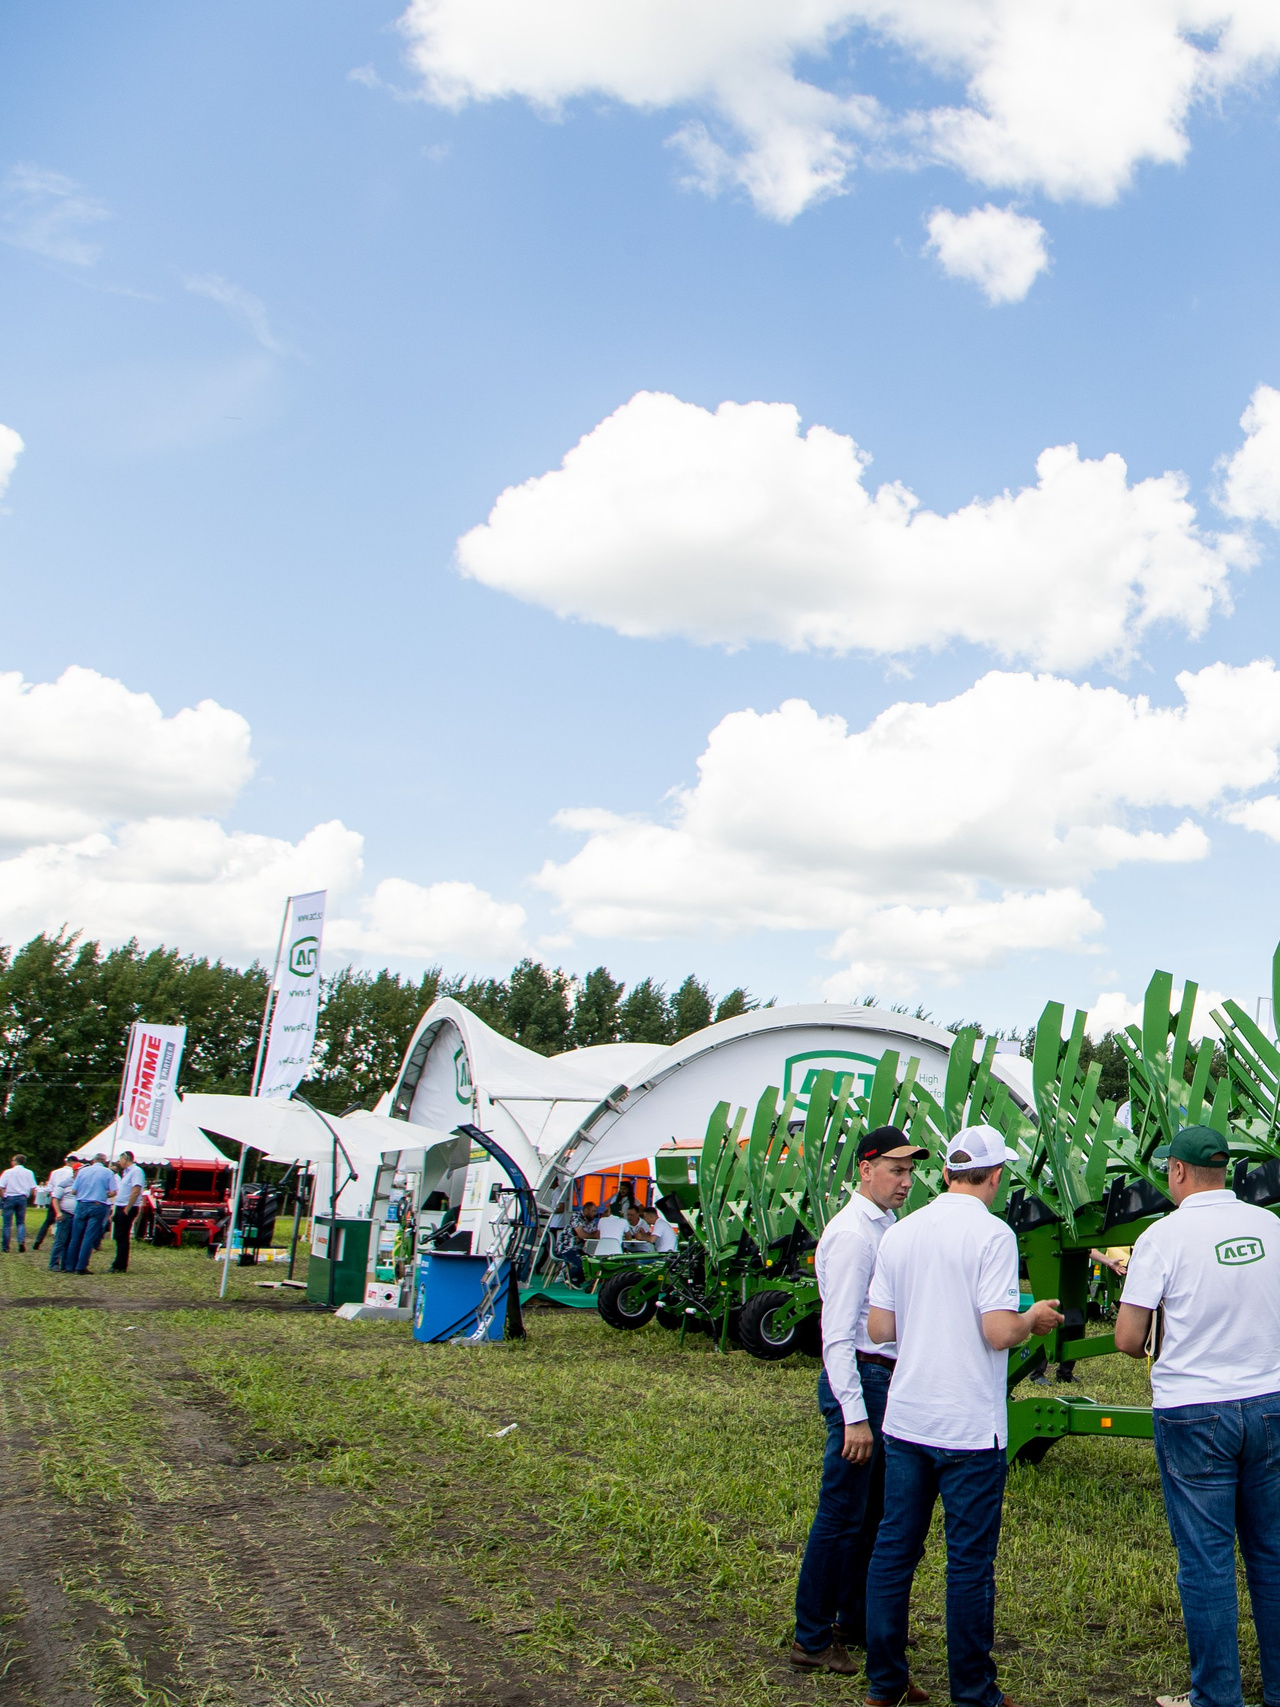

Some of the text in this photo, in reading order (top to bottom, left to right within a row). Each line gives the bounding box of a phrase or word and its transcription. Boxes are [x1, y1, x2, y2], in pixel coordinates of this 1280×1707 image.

[162, 1045, 175, 1077] PARTNER
[134, 1035, 161, 1131] GRIMME
[919, 1073, 939, 1086] High
[1224, 1243, 1257, 1259] ACT
